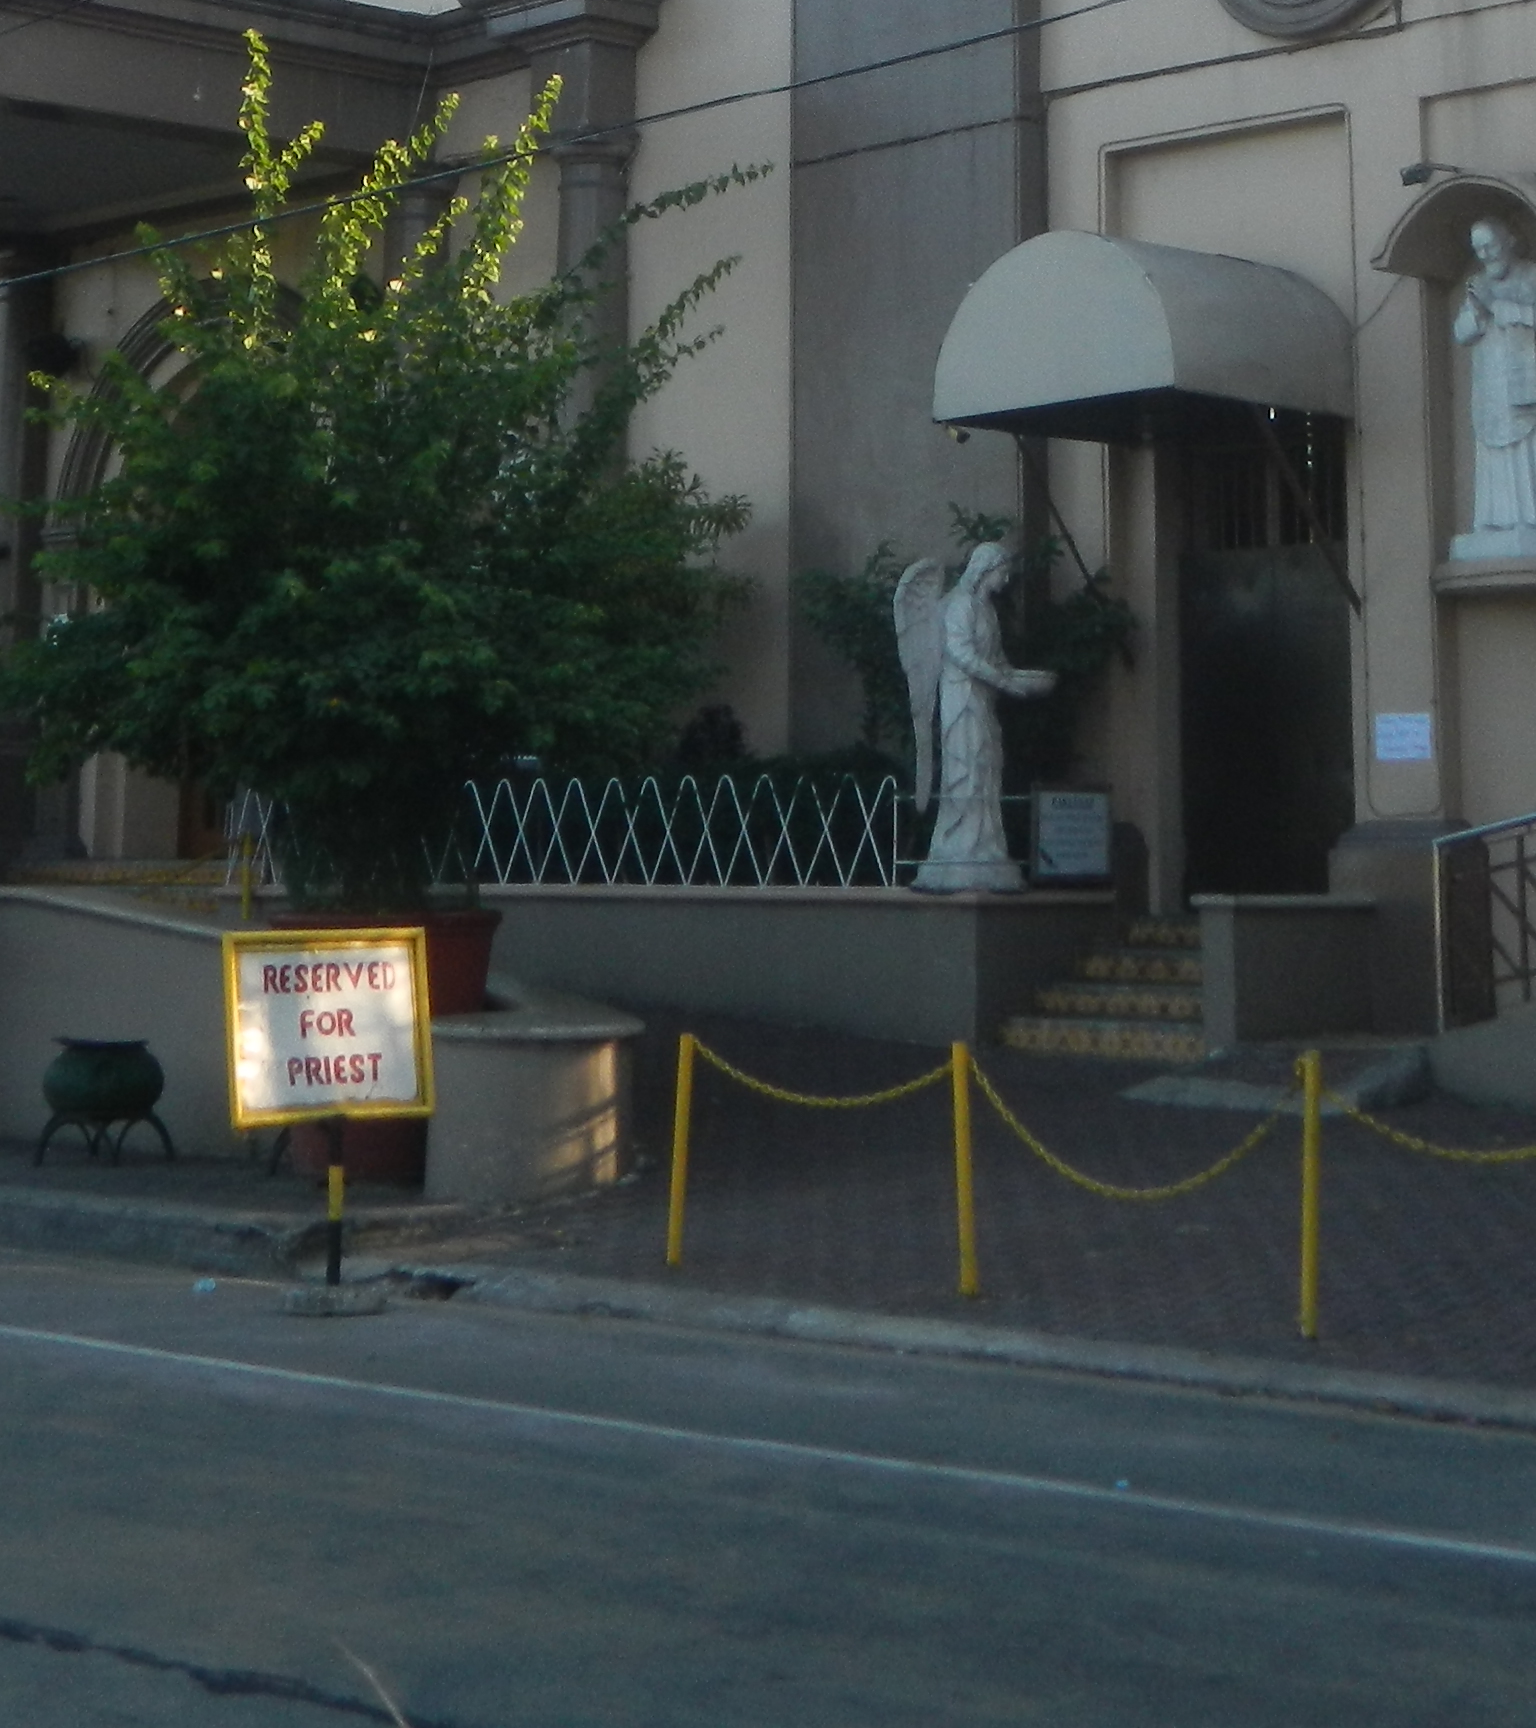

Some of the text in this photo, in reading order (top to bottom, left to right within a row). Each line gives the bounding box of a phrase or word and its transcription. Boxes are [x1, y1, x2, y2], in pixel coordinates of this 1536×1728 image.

[263, 960, 397, 995] RESERVED
[299, 1007, 357, 1040] FOR
[287, 1052, 383, 1087] PRIEST
